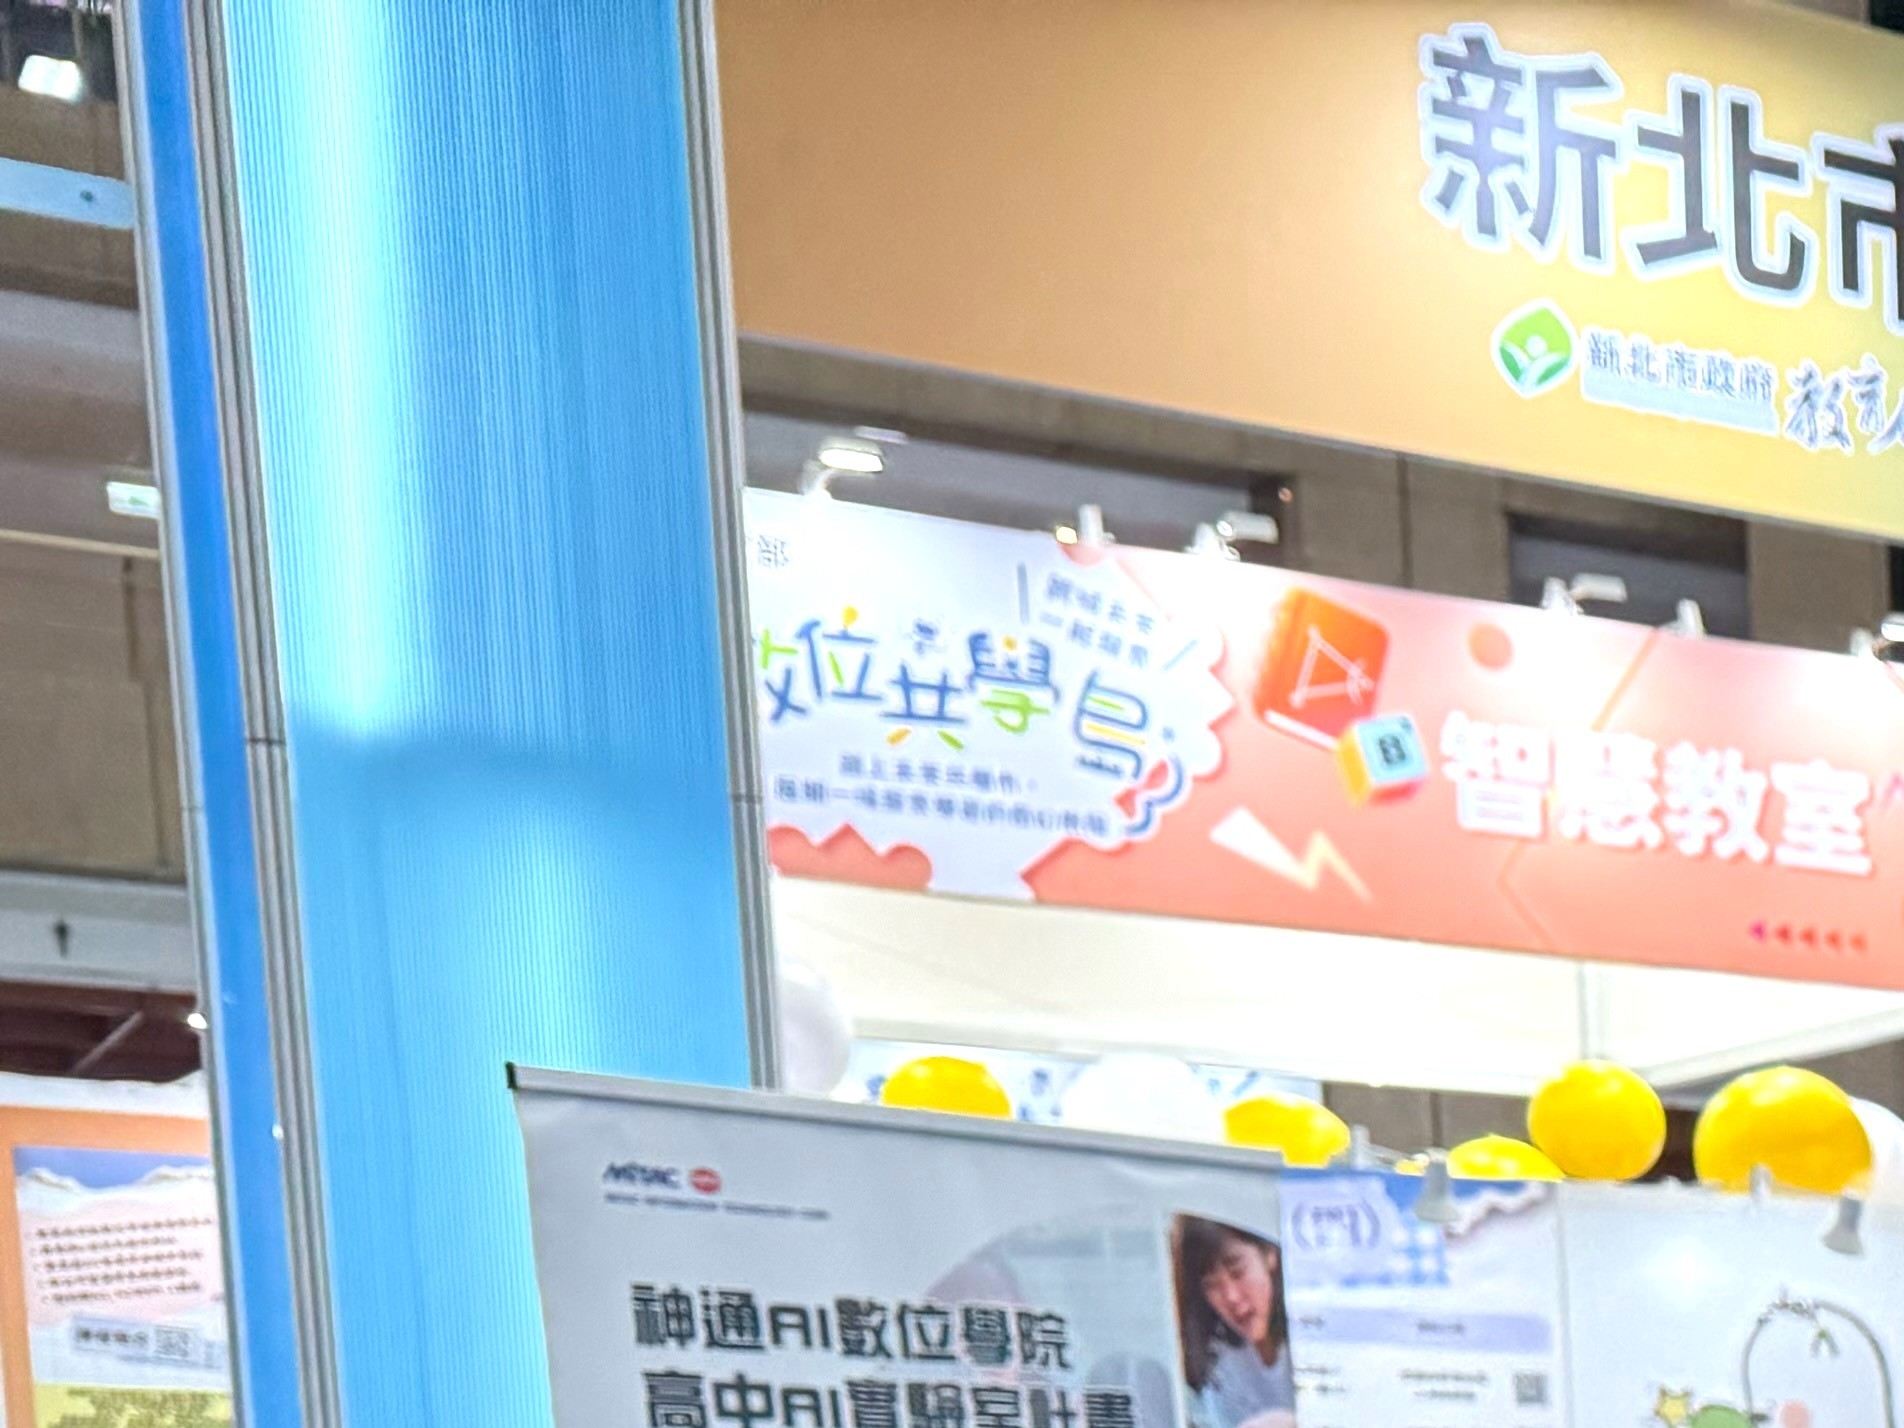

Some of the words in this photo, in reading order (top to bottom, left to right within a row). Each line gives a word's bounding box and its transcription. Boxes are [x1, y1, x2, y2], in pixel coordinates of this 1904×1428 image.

[1586, 332, 1775, 402] 新北市政府
[1441, 711, 1874, 877] 智慧教室
[630, 1283, 1071, 1371] 神通AI數位學院
